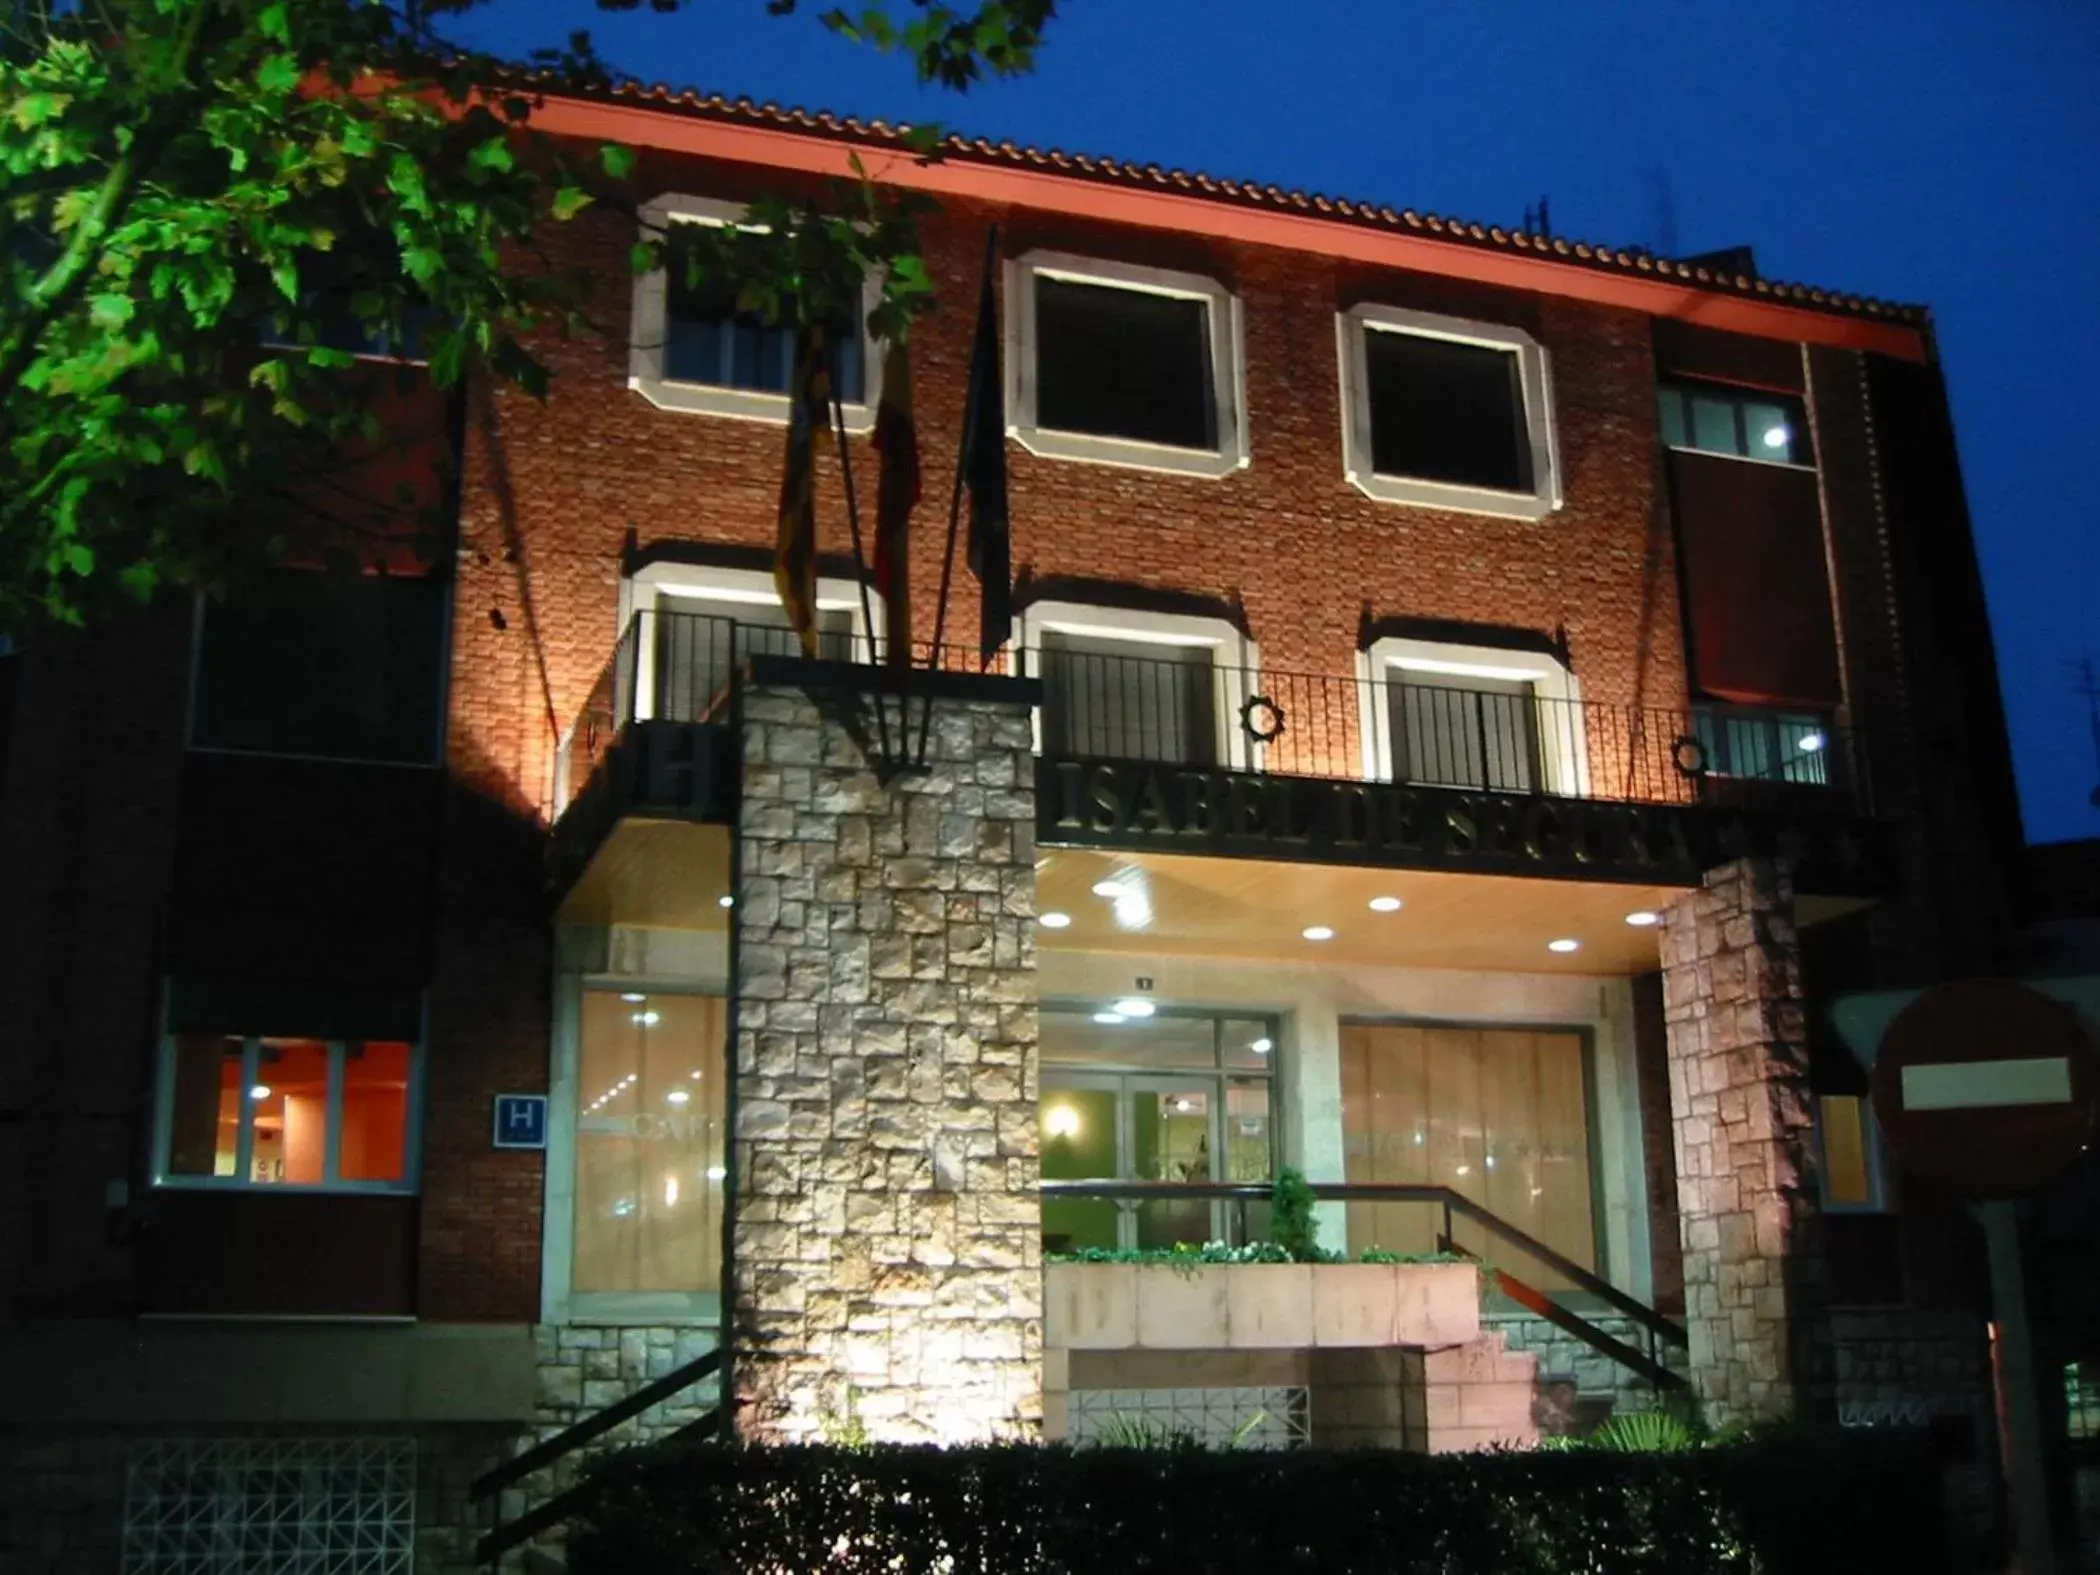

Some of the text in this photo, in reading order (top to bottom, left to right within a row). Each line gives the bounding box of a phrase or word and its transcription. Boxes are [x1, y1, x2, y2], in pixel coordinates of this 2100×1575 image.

[1055, 761, 1697, 869] ISABEL DE SEGURA
[510, 1101, 534, 1129] H
